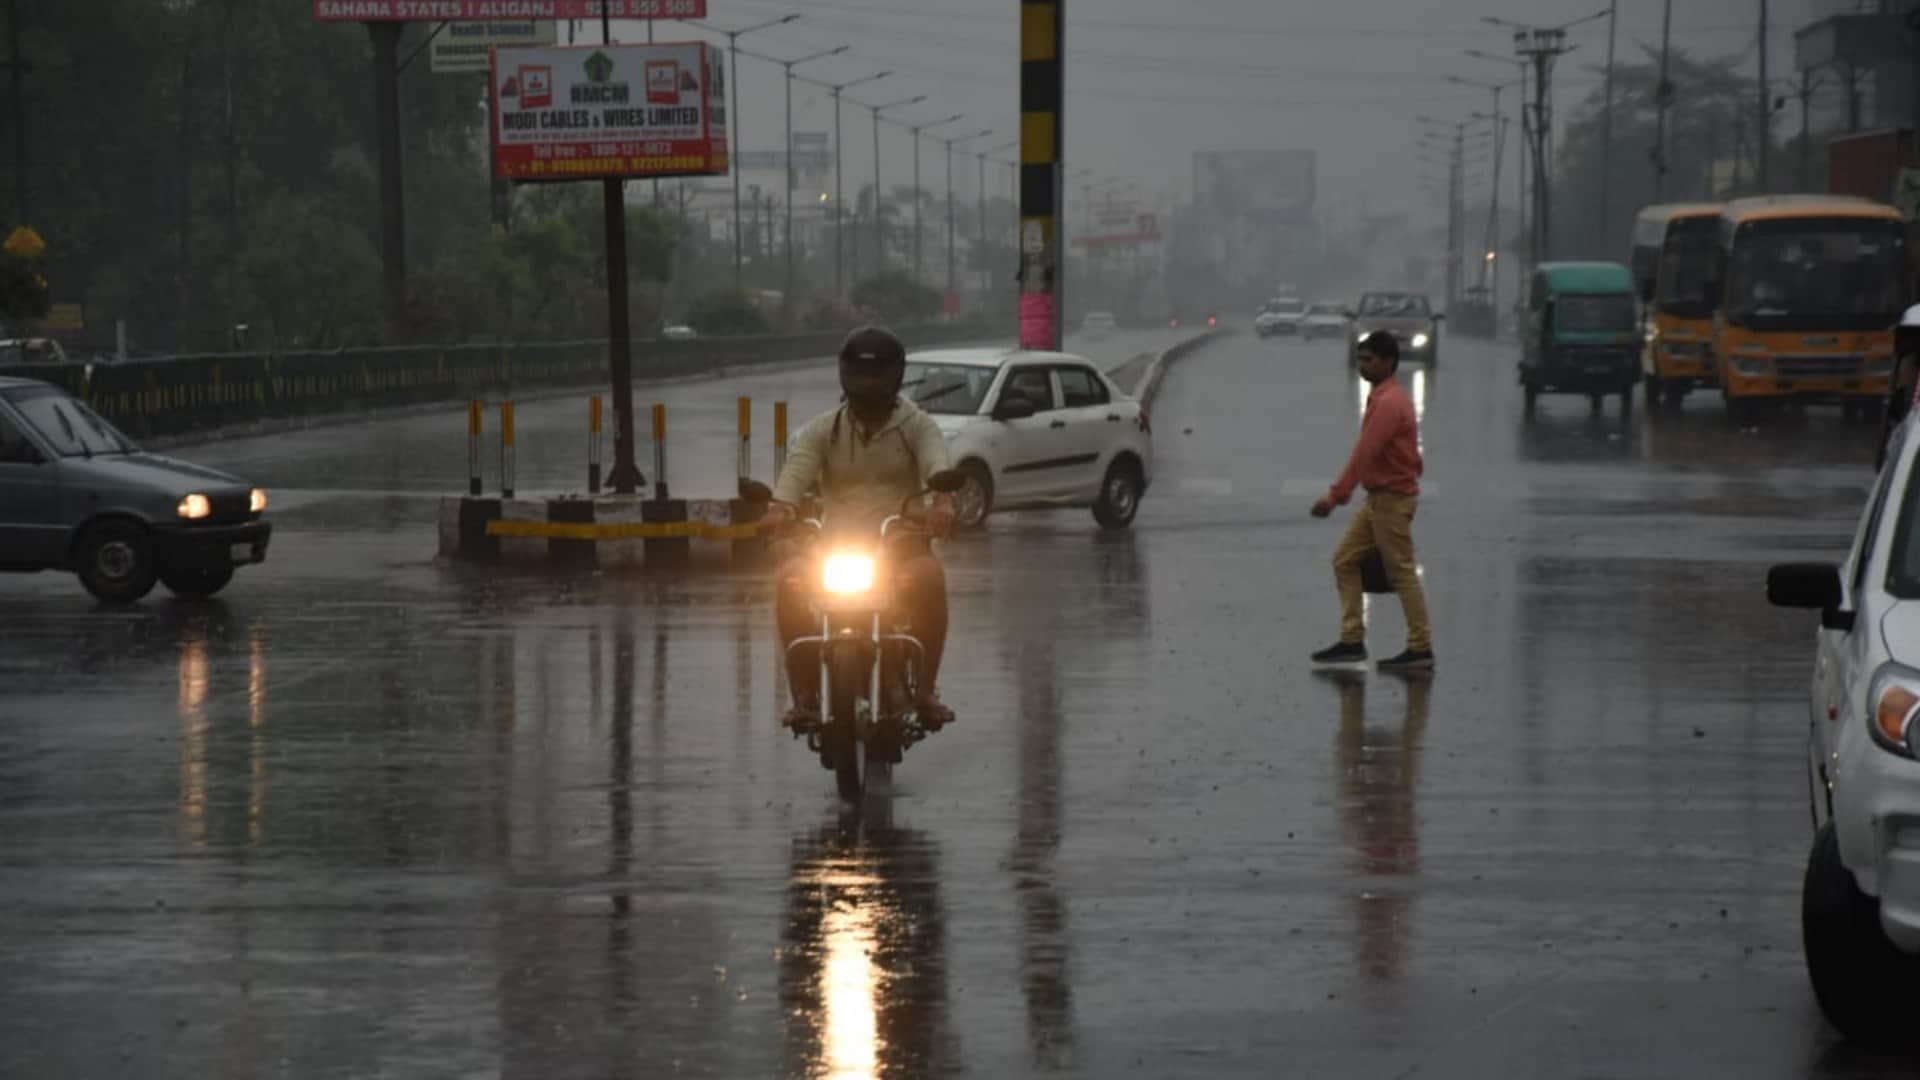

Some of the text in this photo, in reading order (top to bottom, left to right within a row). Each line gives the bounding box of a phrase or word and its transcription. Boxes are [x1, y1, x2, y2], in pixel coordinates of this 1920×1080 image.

[318, 0, 391, 17] SAHARA
[396, 0, 462, 17] STATES
[479, 0, 556, 17] ALIGANJ
[502, 112, 538, 130] MODI
[541, 110, 590, 129] CABLES
[603, 108, 645, 127] WIRES
[647, 107, 699, 126] LIMITED
